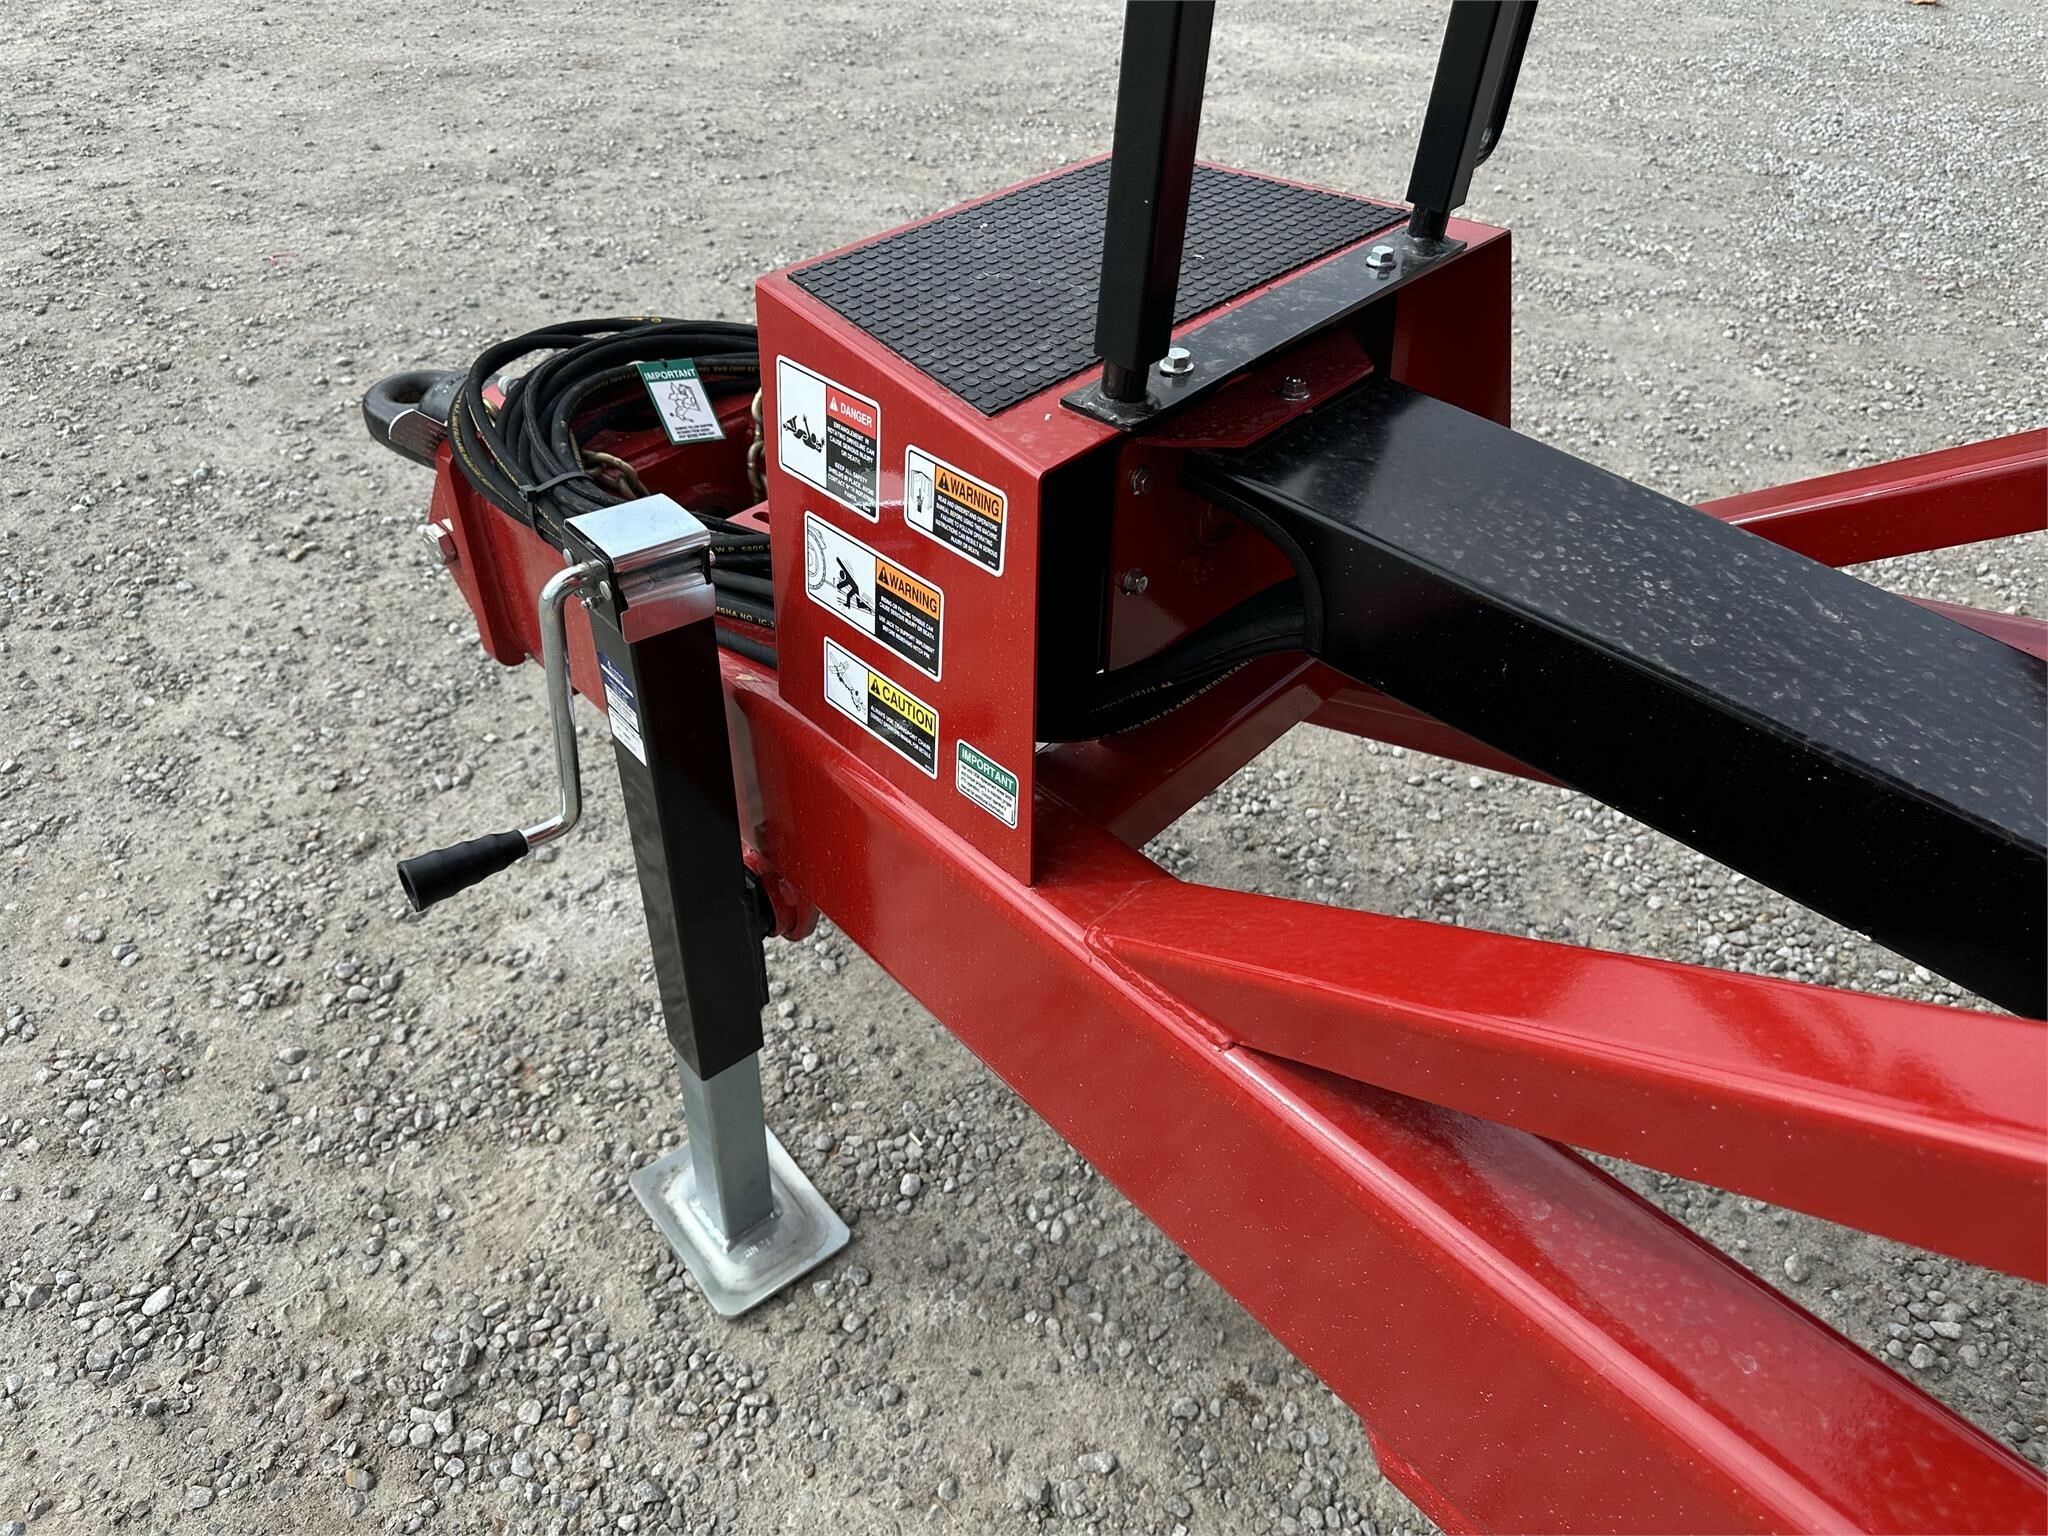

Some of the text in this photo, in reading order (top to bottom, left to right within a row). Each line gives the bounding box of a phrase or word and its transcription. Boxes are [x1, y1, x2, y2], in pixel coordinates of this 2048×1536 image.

[643, 368, 697, 380] IMPORTANT
[840, 401, 871, 428] DANGER
[950, 477, 999, 517] WARNING
[889, 572, 937, 613] WARNING
[882, 684, 932, 731] CAUTION
[1162, 694, 1197, 717] FLAME
[962, 748, 1013, 791] IMPORTANT
